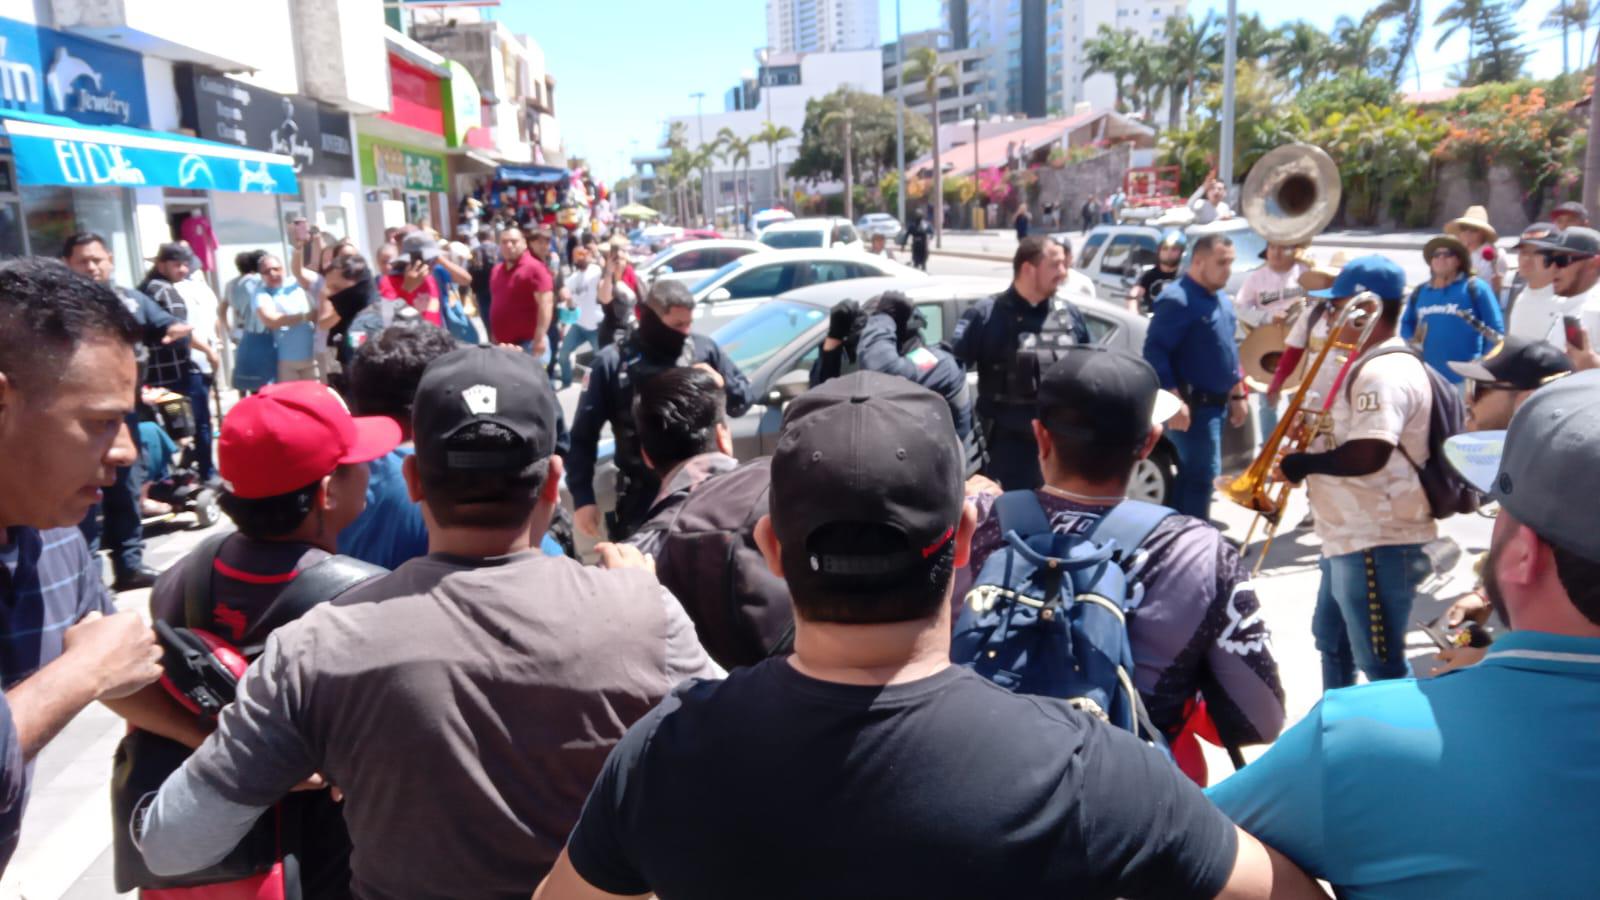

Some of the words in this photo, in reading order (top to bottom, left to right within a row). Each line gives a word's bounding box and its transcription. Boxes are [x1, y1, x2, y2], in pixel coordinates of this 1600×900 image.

[80, 90, 129, 123] Jewelry
[54, 140, 86, 184] El
[1357, 391, 1380, 412] 01
